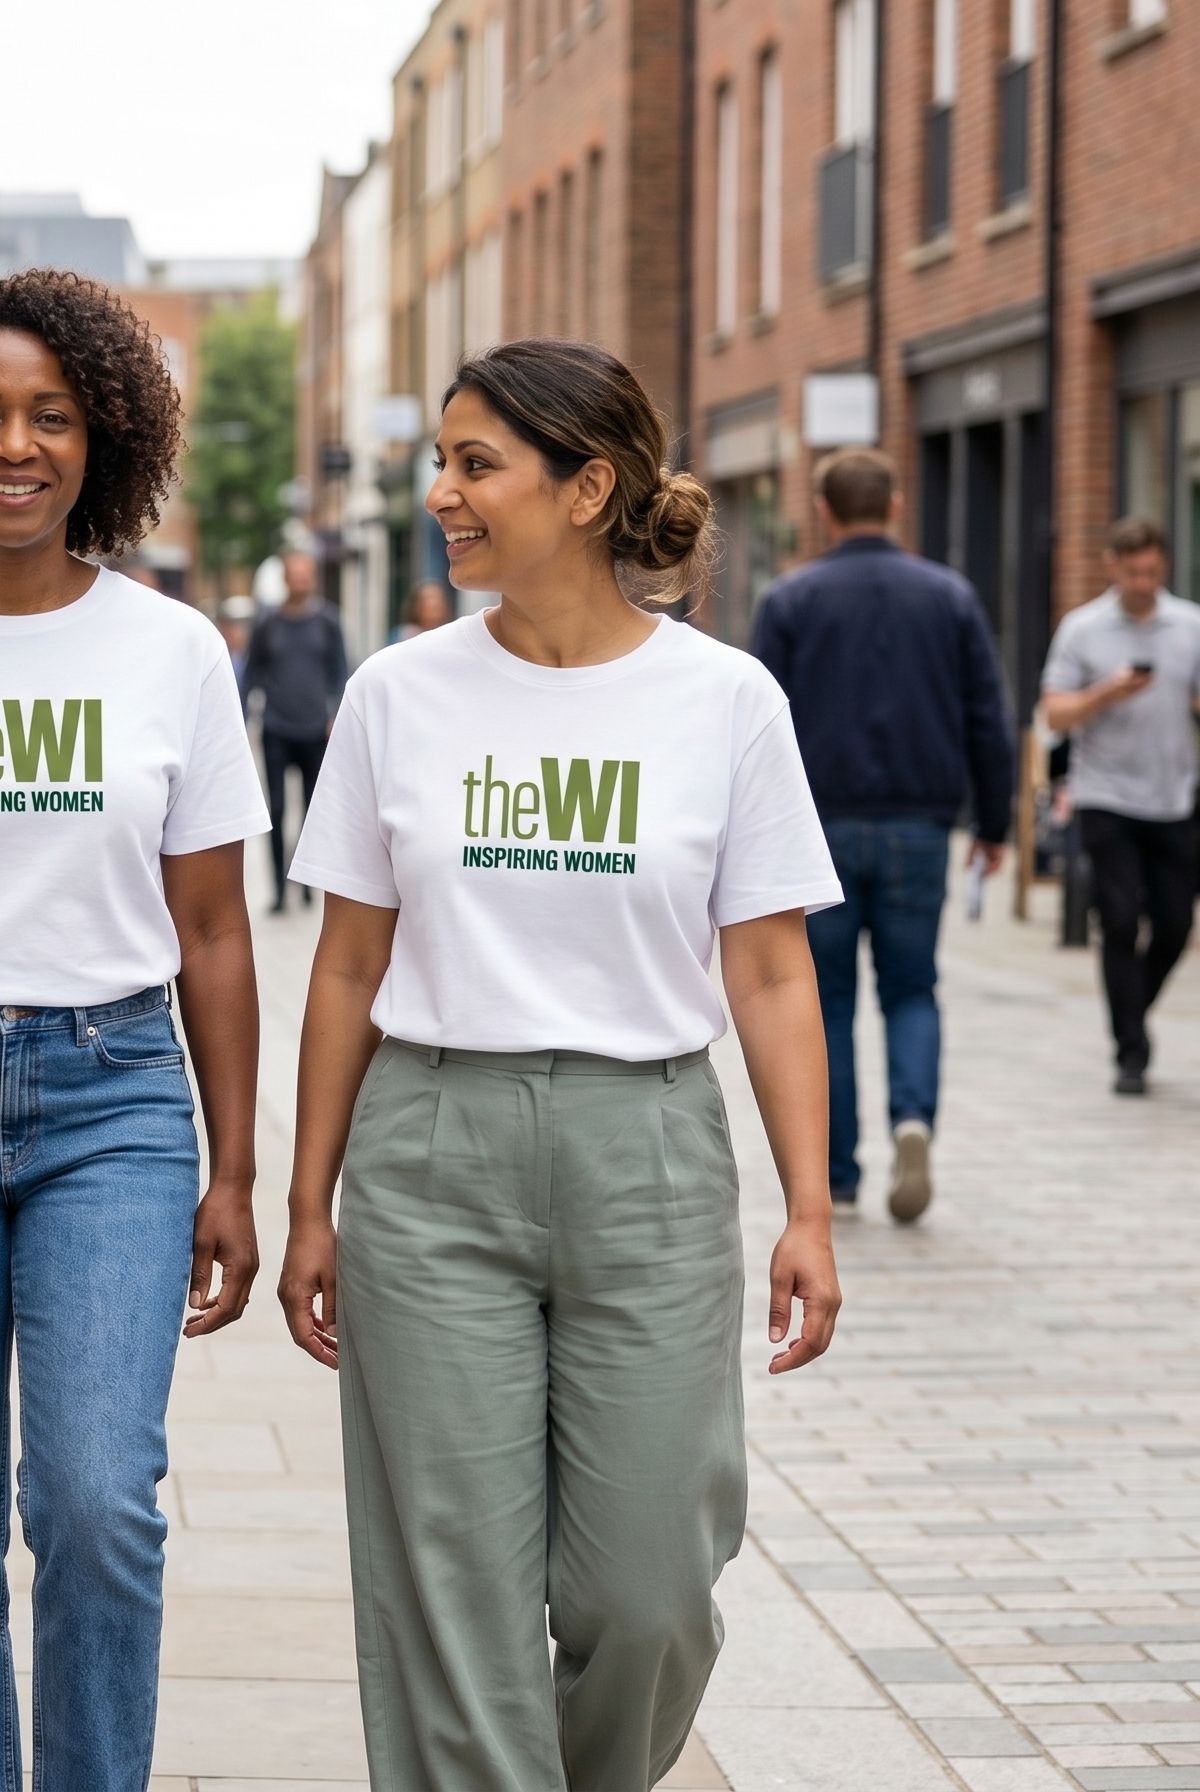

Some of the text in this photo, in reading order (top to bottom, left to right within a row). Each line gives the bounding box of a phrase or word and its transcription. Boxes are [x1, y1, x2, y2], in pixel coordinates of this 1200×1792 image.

[31, 791, 104, 812] WOMEN
[463, 846, 636, 874] INSPIRING WOMEN
